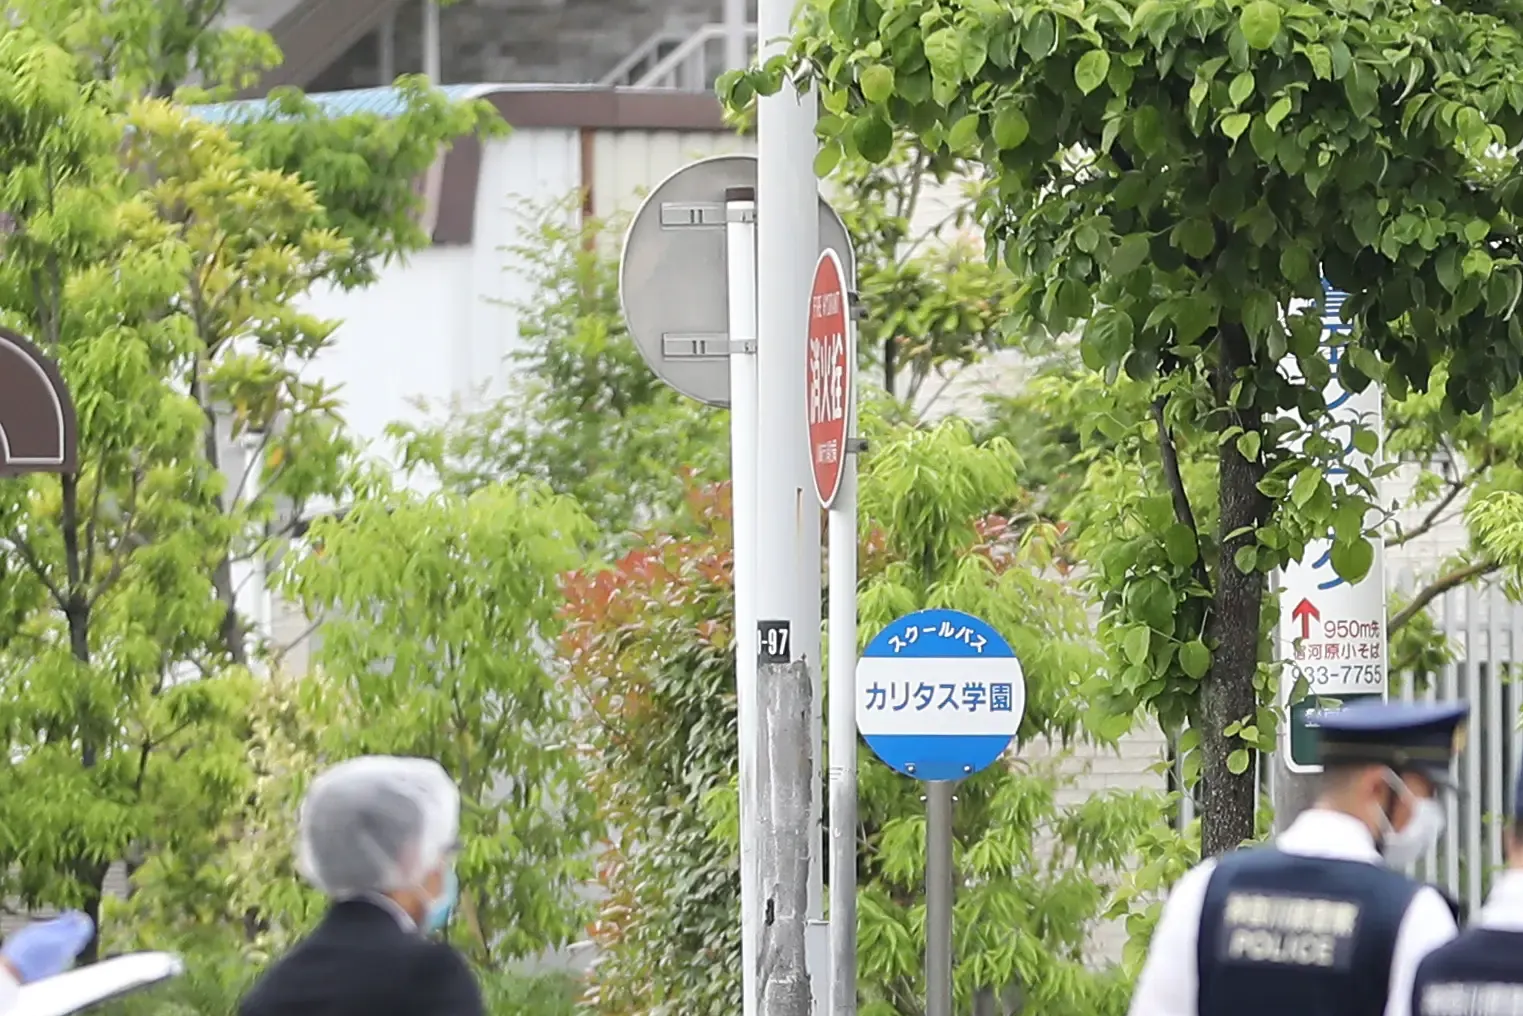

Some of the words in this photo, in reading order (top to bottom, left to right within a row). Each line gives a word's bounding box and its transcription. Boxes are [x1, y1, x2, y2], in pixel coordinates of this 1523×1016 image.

[809, 332, 844, 425] 消火栓
[757, 628, 789, 656] -97
[888, 621, 988, 653] スクールバス
[1324, 619, 1381, 639] 950m先
[865, 681, 1013, 713] カリタス学園
[1228, 928, 1334, 967] POLICE
